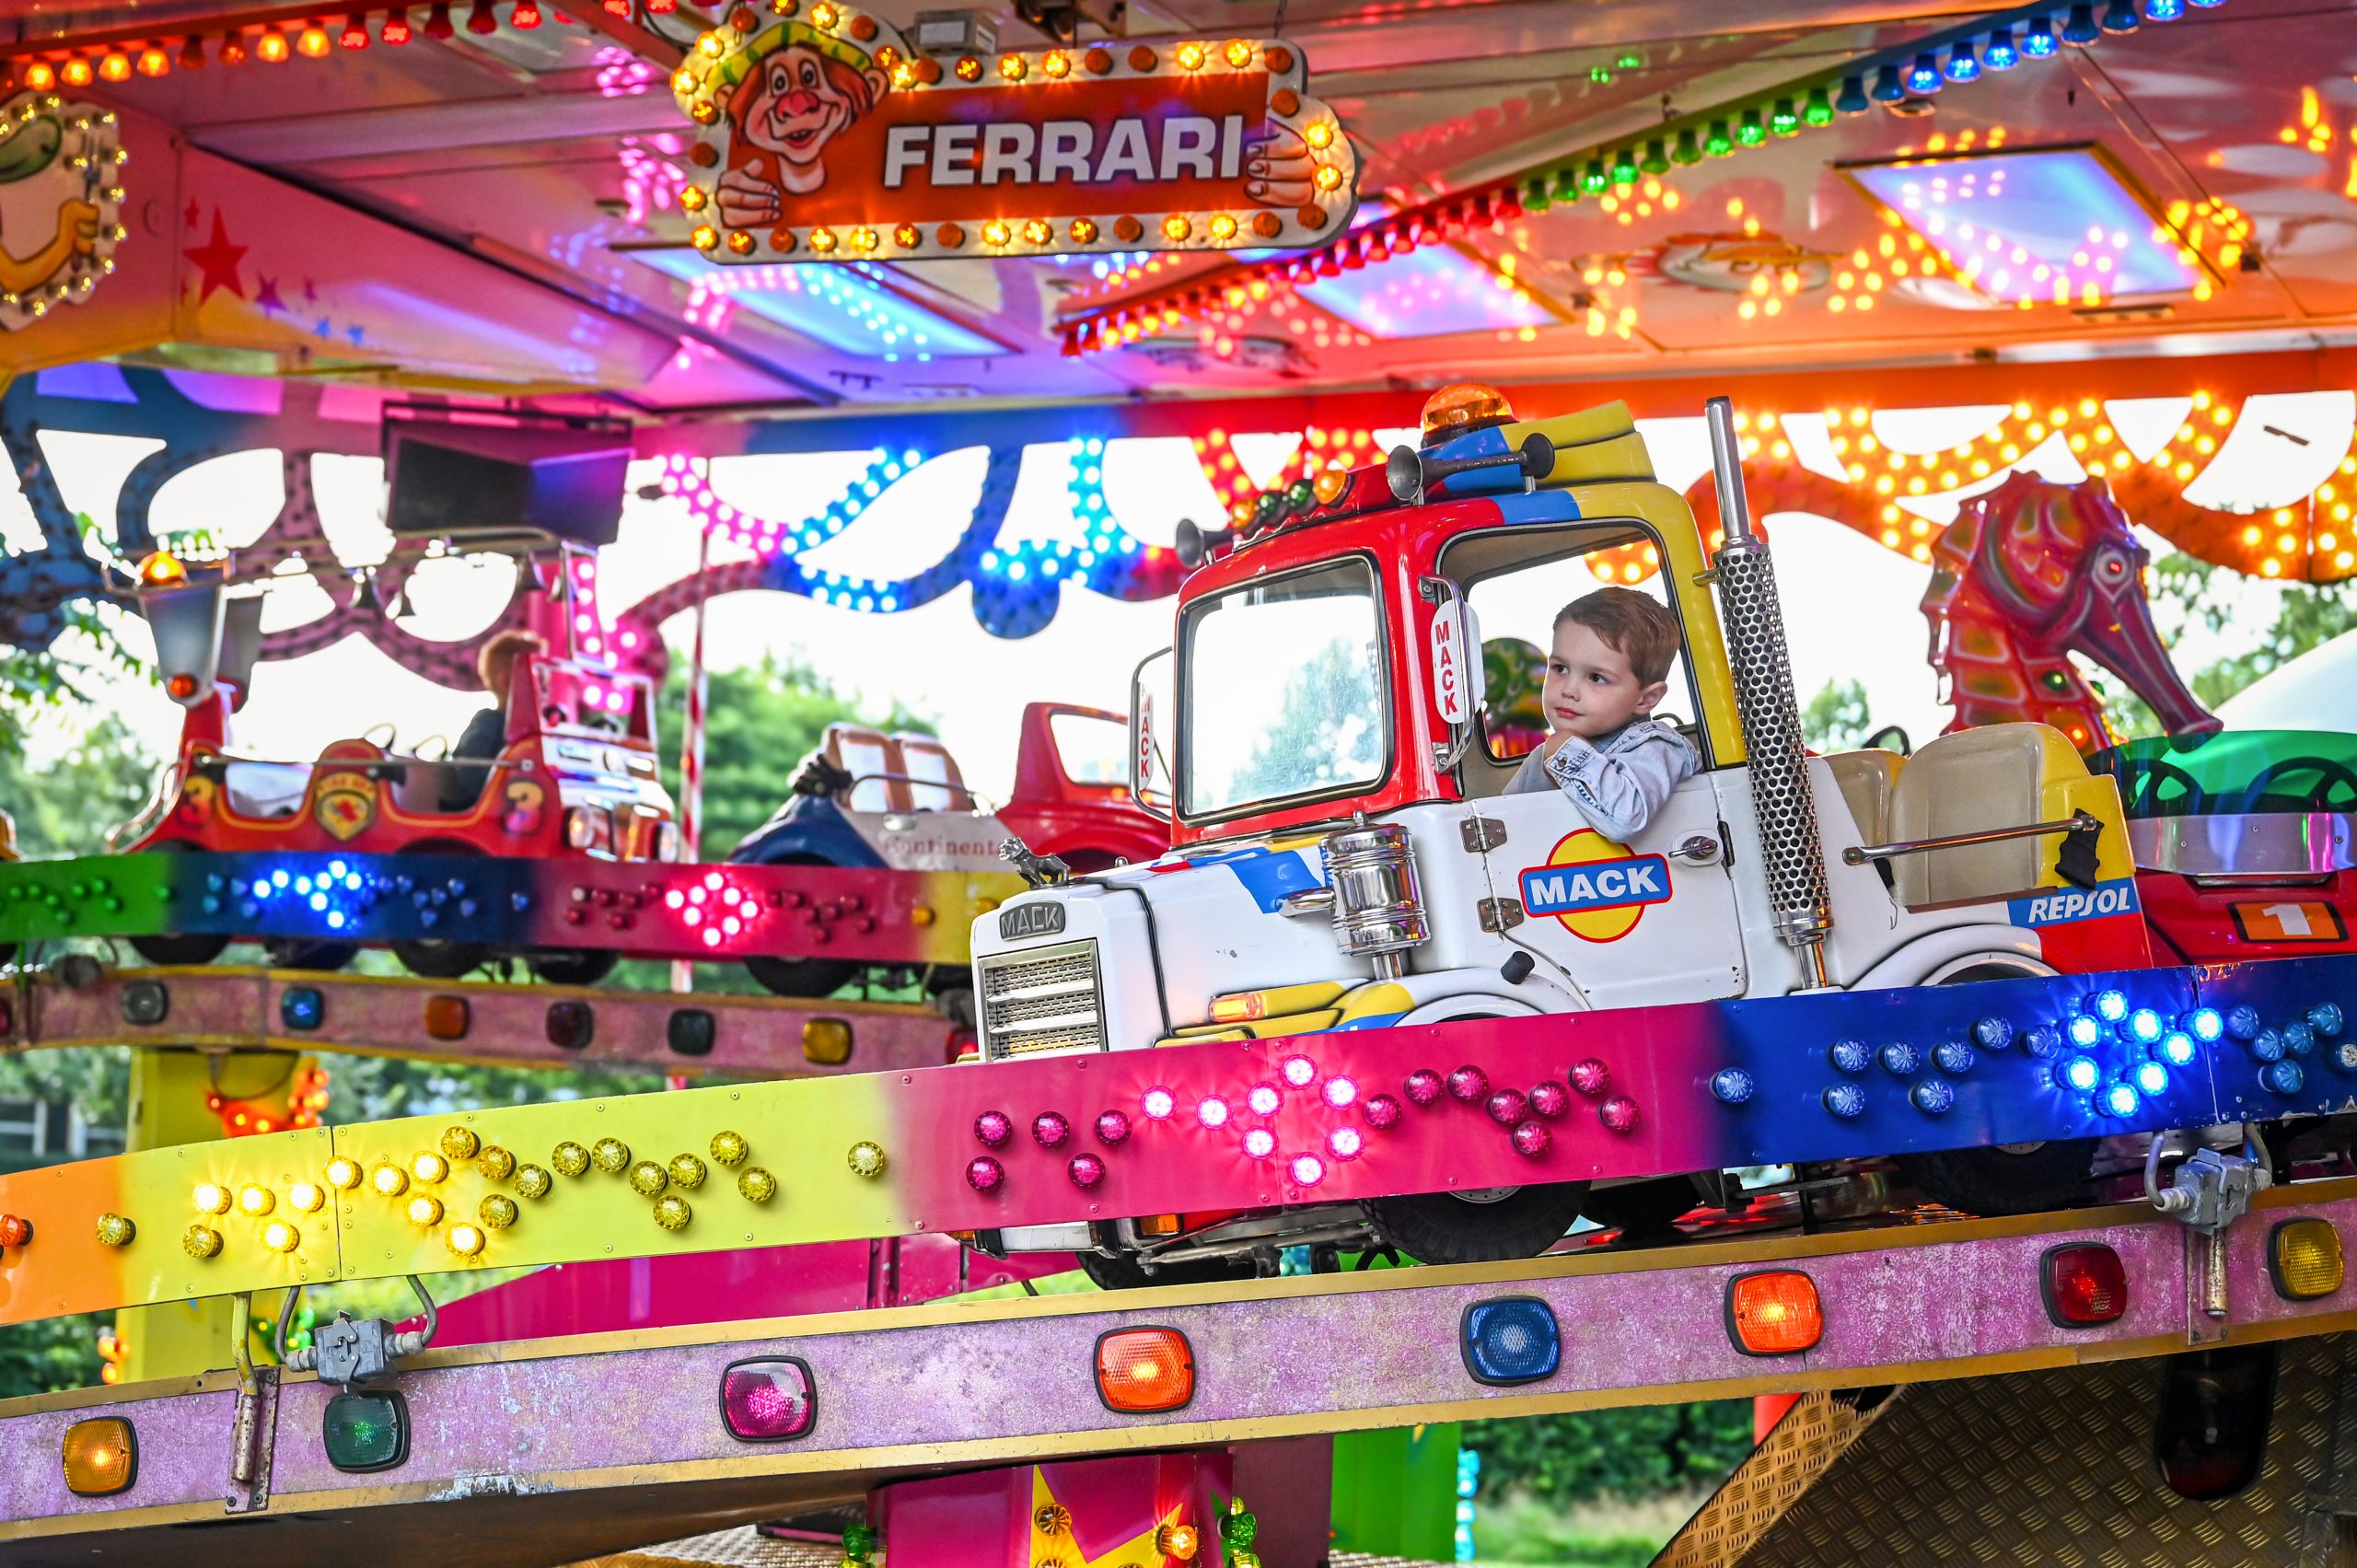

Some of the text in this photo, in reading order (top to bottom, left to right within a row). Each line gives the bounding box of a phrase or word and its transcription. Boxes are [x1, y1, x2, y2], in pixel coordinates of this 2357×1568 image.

[884, 115, 1243, 187] FERRARI
[1435, 621, 1457, 715] MACK
[1529, 865, 1660, 906] MACK
[1001, 906, 1059, 937] MACK
[2028, 887, 2131, 923] REPSOL
[2262, 904, 2312, 935] 1
